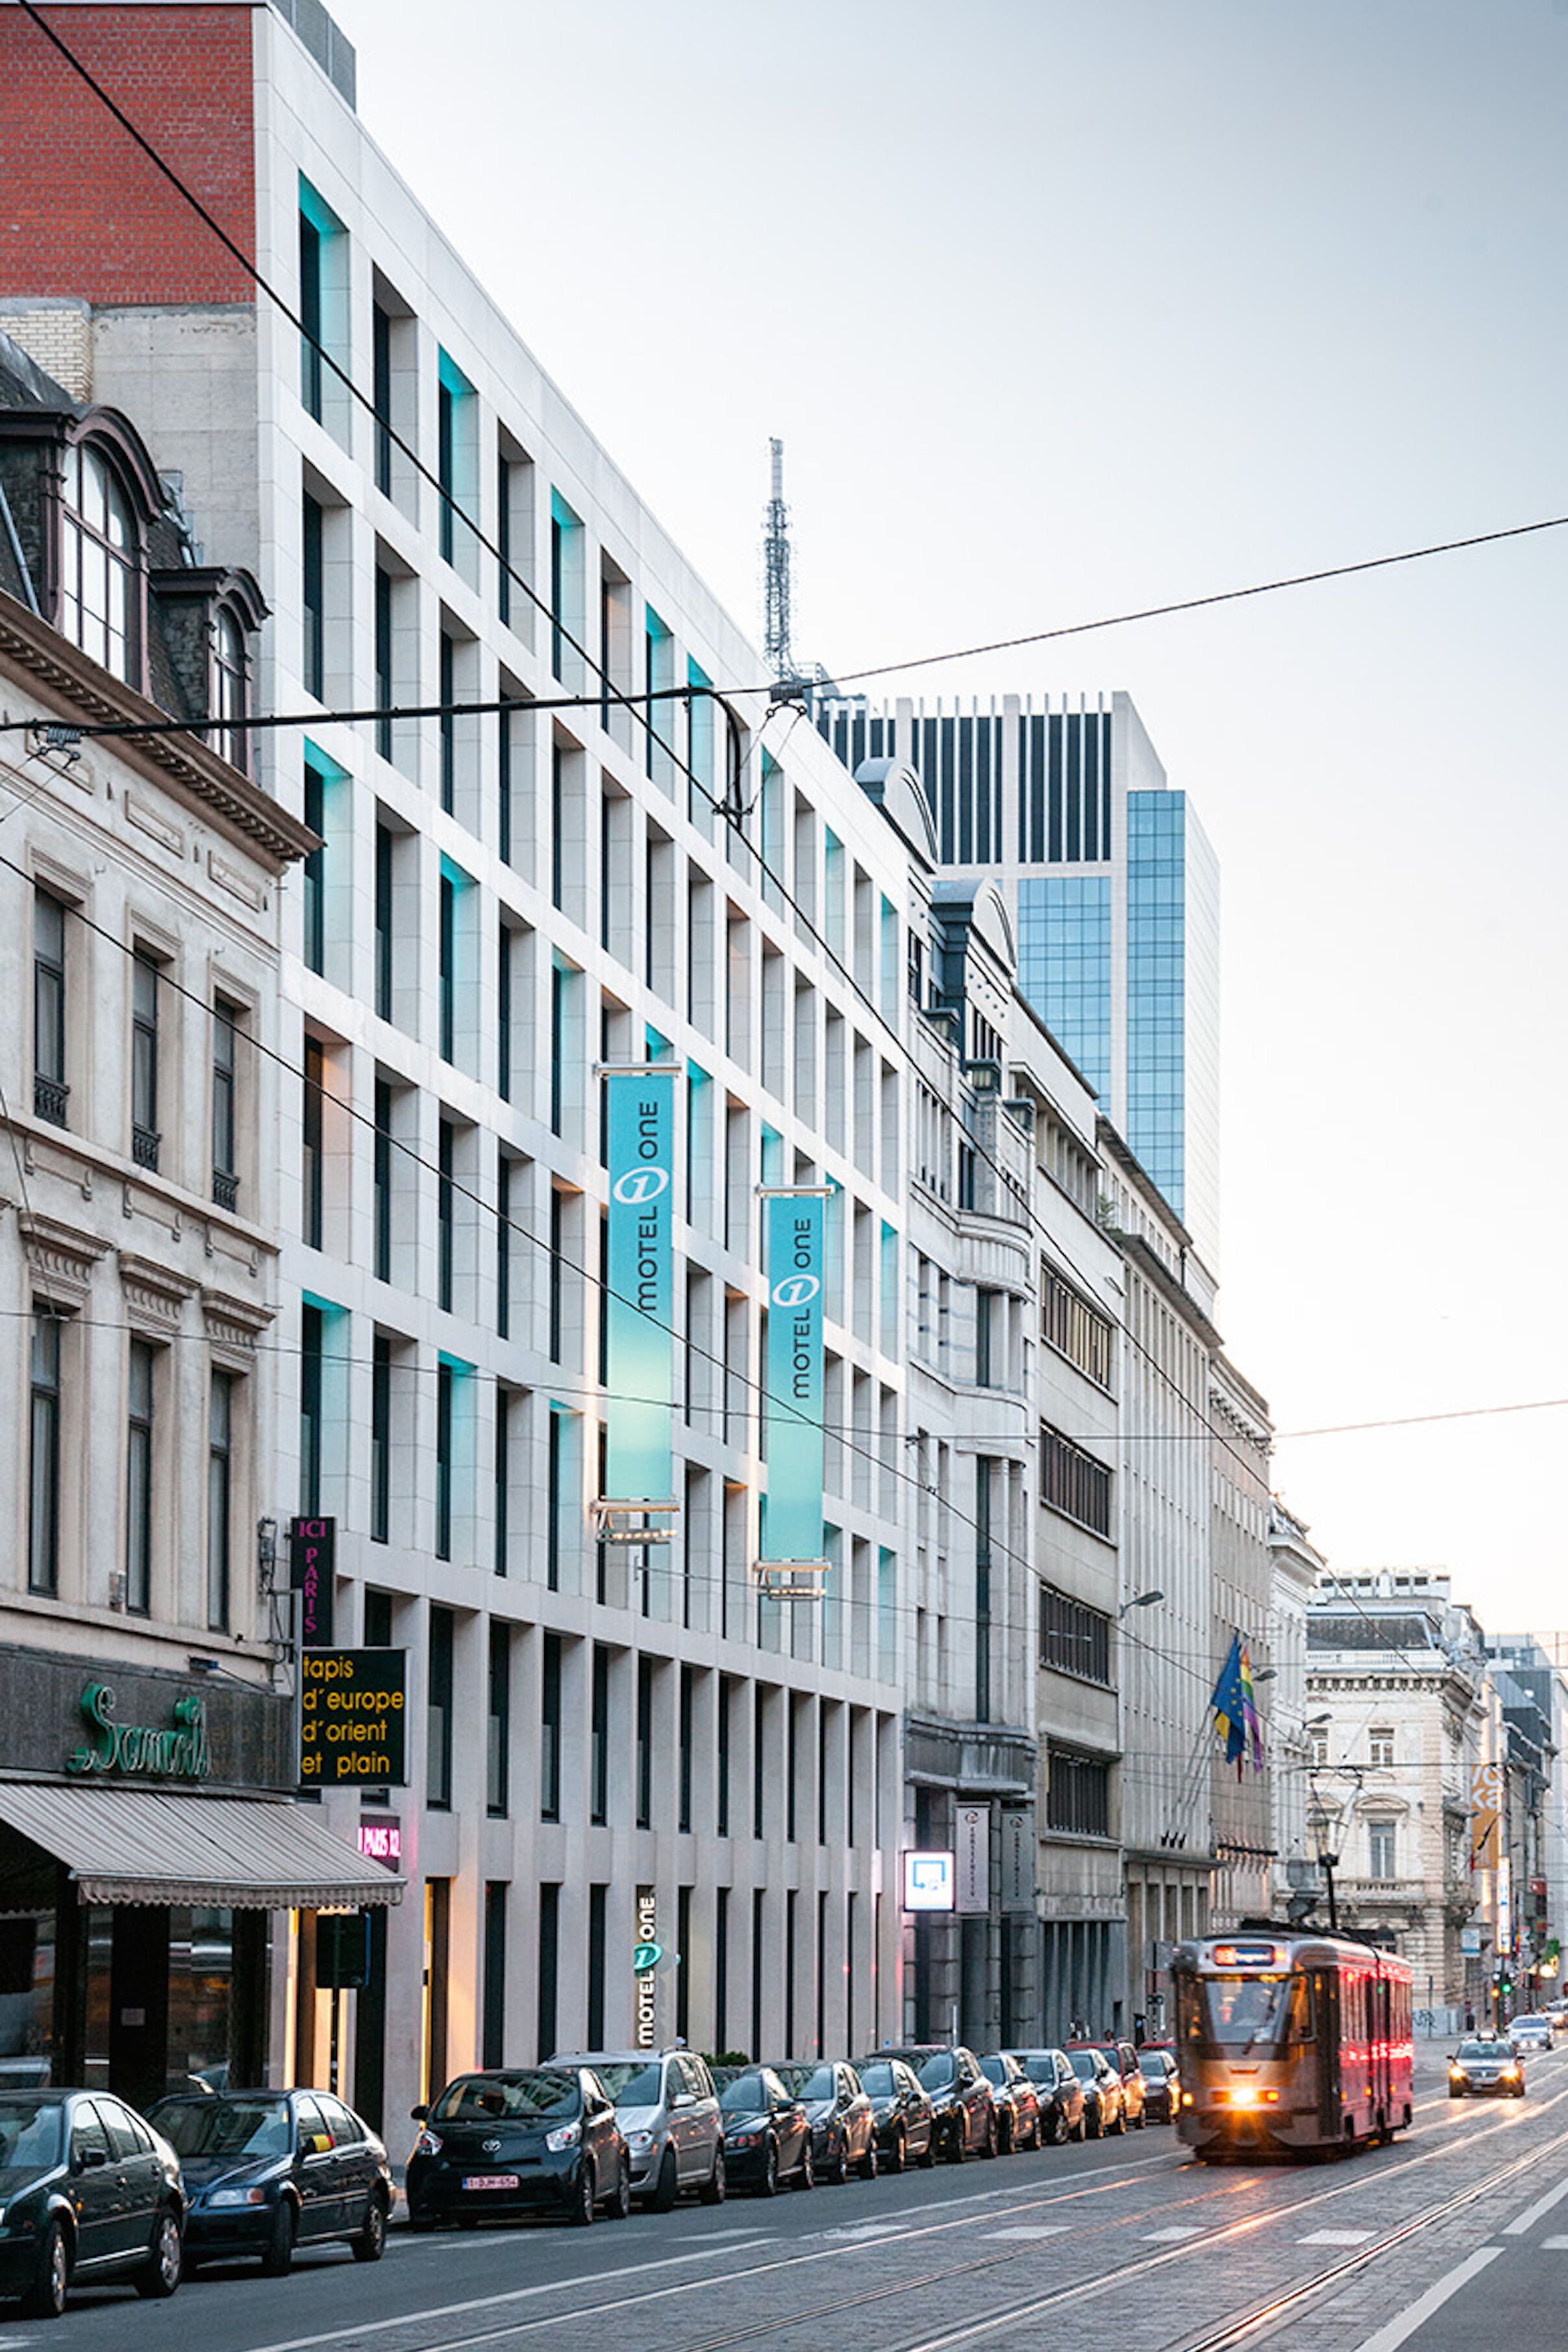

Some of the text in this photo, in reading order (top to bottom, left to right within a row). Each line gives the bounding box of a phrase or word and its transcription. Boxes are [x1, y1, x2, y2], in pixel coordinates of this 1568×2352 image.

[299, 1520, 325, 1538] ICI
[304, 1547, 319, 1634] PARIS
[303, 1656, 354, 1683] tapis
[301, 1751, 390, 1779] et plain
